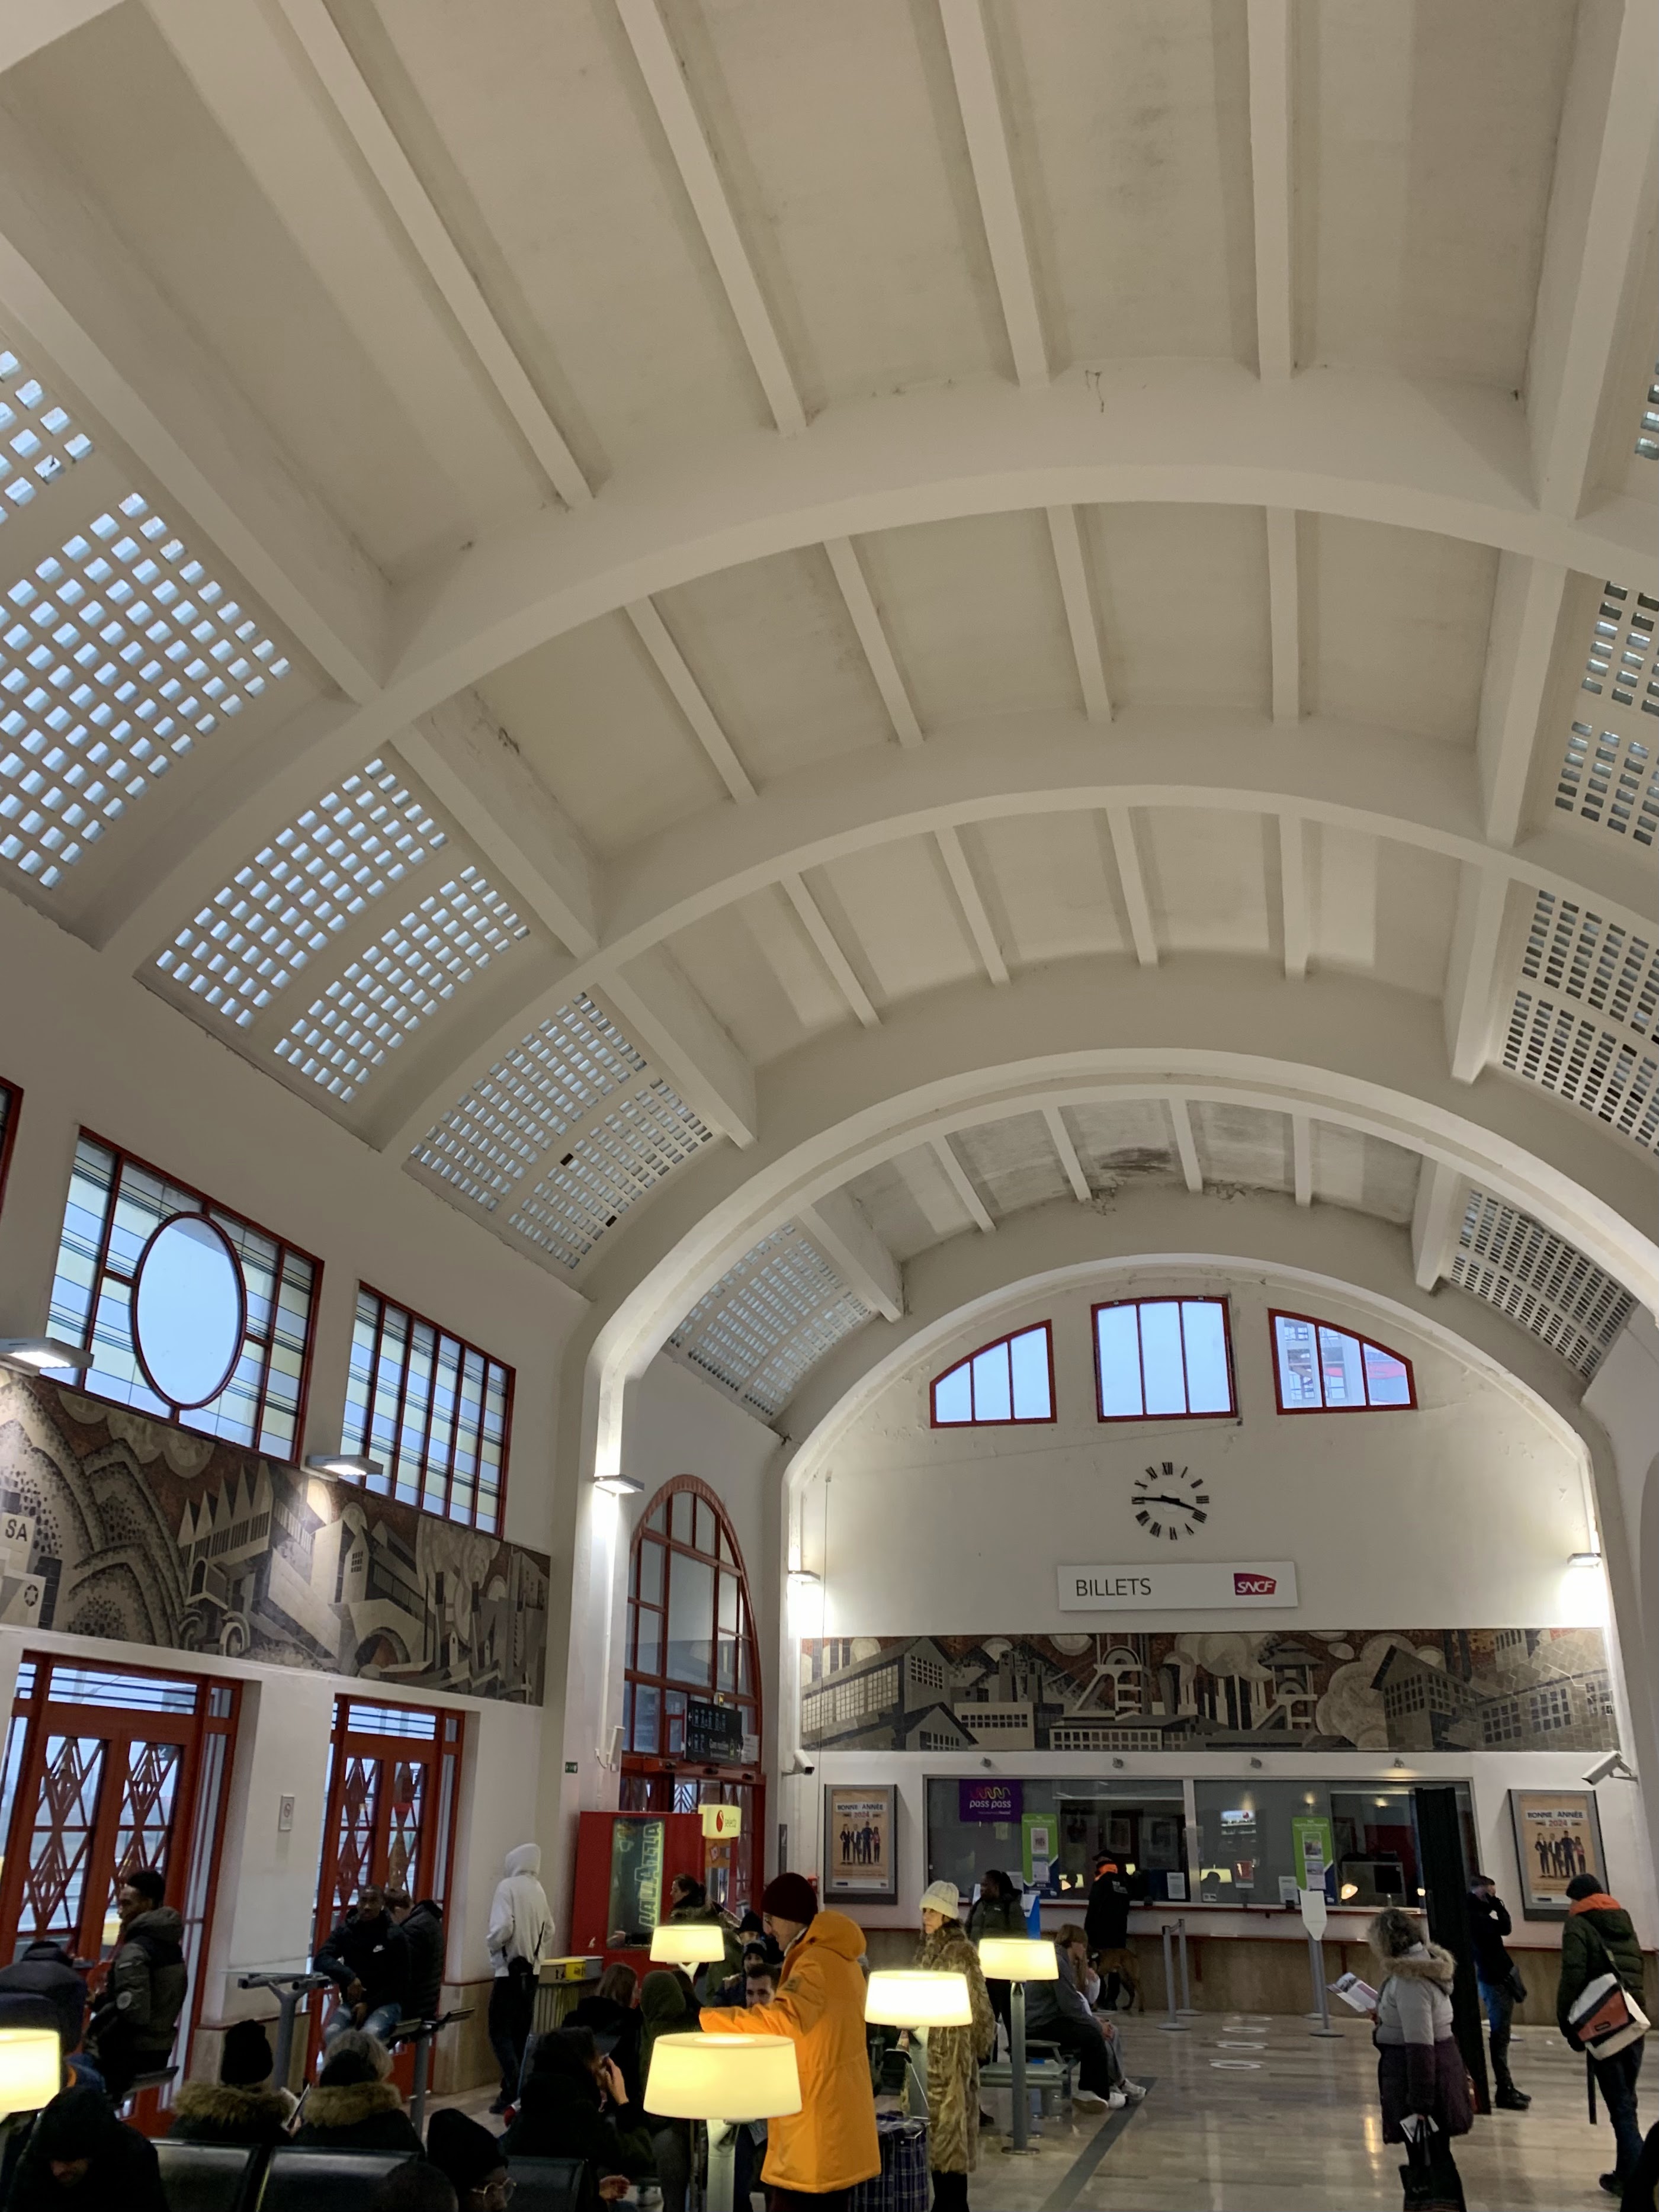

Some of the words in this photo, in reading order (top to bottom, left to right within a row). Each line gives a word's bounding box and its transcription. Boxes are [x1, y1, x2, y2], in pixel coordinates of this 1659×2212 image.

[5, 1518, 27, 1542] SA
[1076, 1578, 1151, 1596] BILLETS
[1236, 1580, 1274, 1593] SNCF
[970, 1800, 990, 1809] pass
[991, 1800, 1011, 1809] pass
[634, 1822, 662, 1928] LAVAZZA
